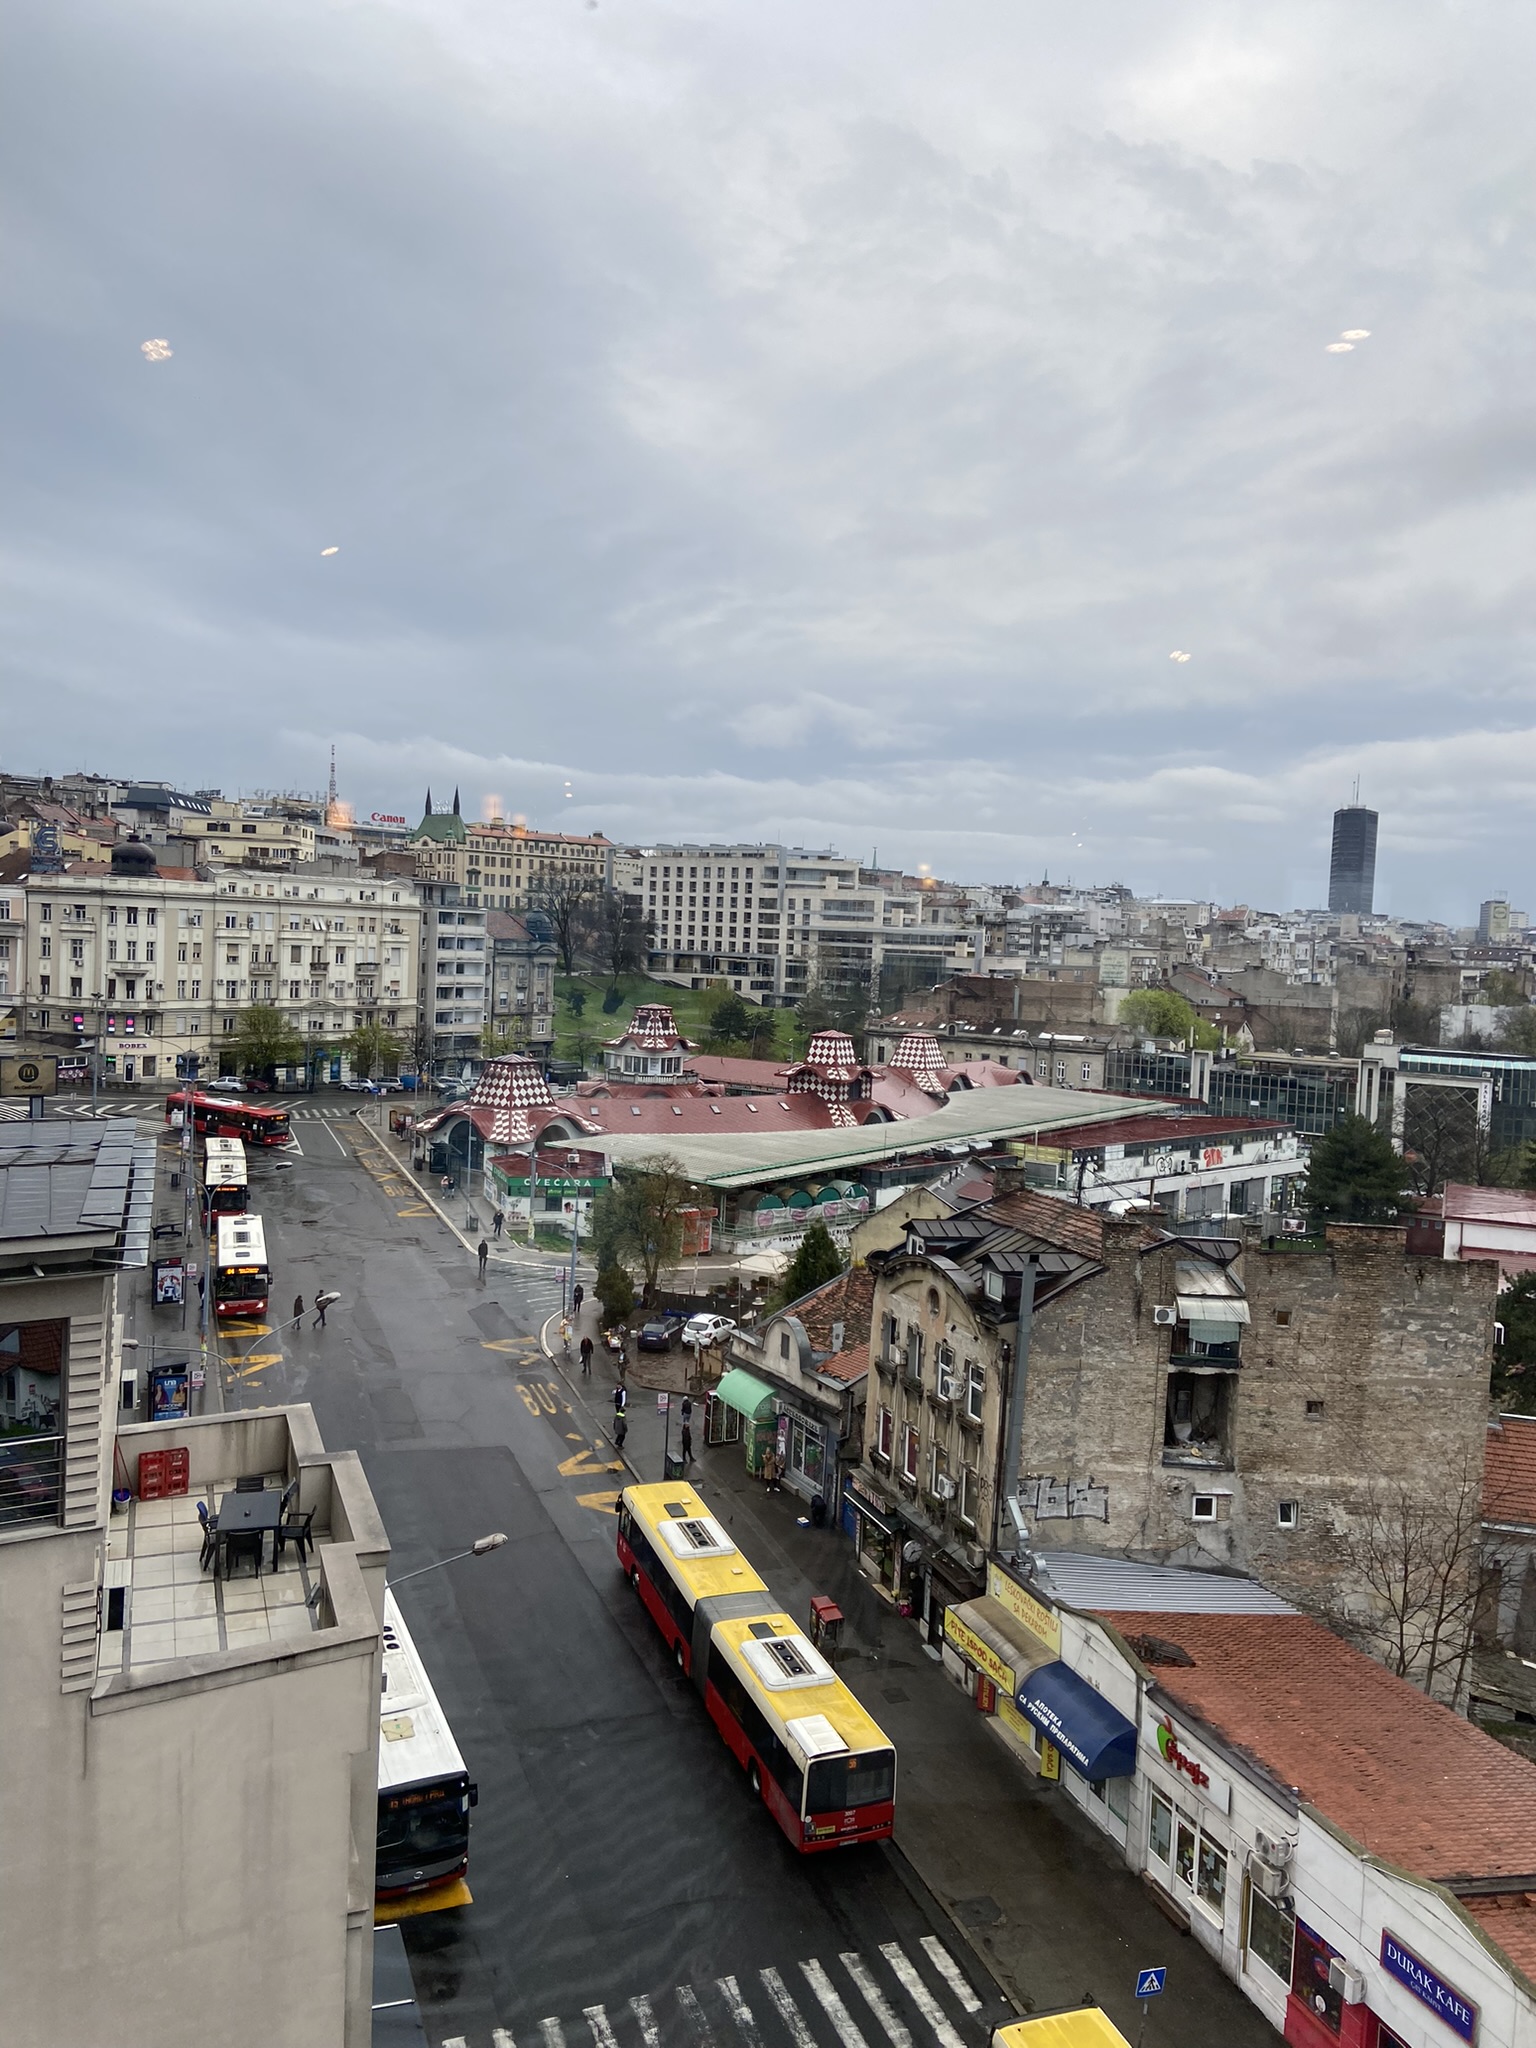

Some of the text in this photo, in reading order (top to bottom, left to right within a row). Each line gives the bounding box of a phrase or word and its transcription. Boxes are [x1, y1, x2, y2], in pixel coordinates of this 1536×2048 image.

[371, 812, 405, 824] Canon
[384, 1185, 414, 1197] BUS
[515, 1382, 573, 1416] BUS
[1034, 1699, 1062, 1728] АПОТЕКА
[1019, 1694, 1027, 1705] СА
[1027, 1702, 1050, 1727] РУСКИМ
[1050, 1724, 1089, 1767] ПРЕПАРАТИМА
[1387, 1943, 1470, 2025] DURAK KAFE
